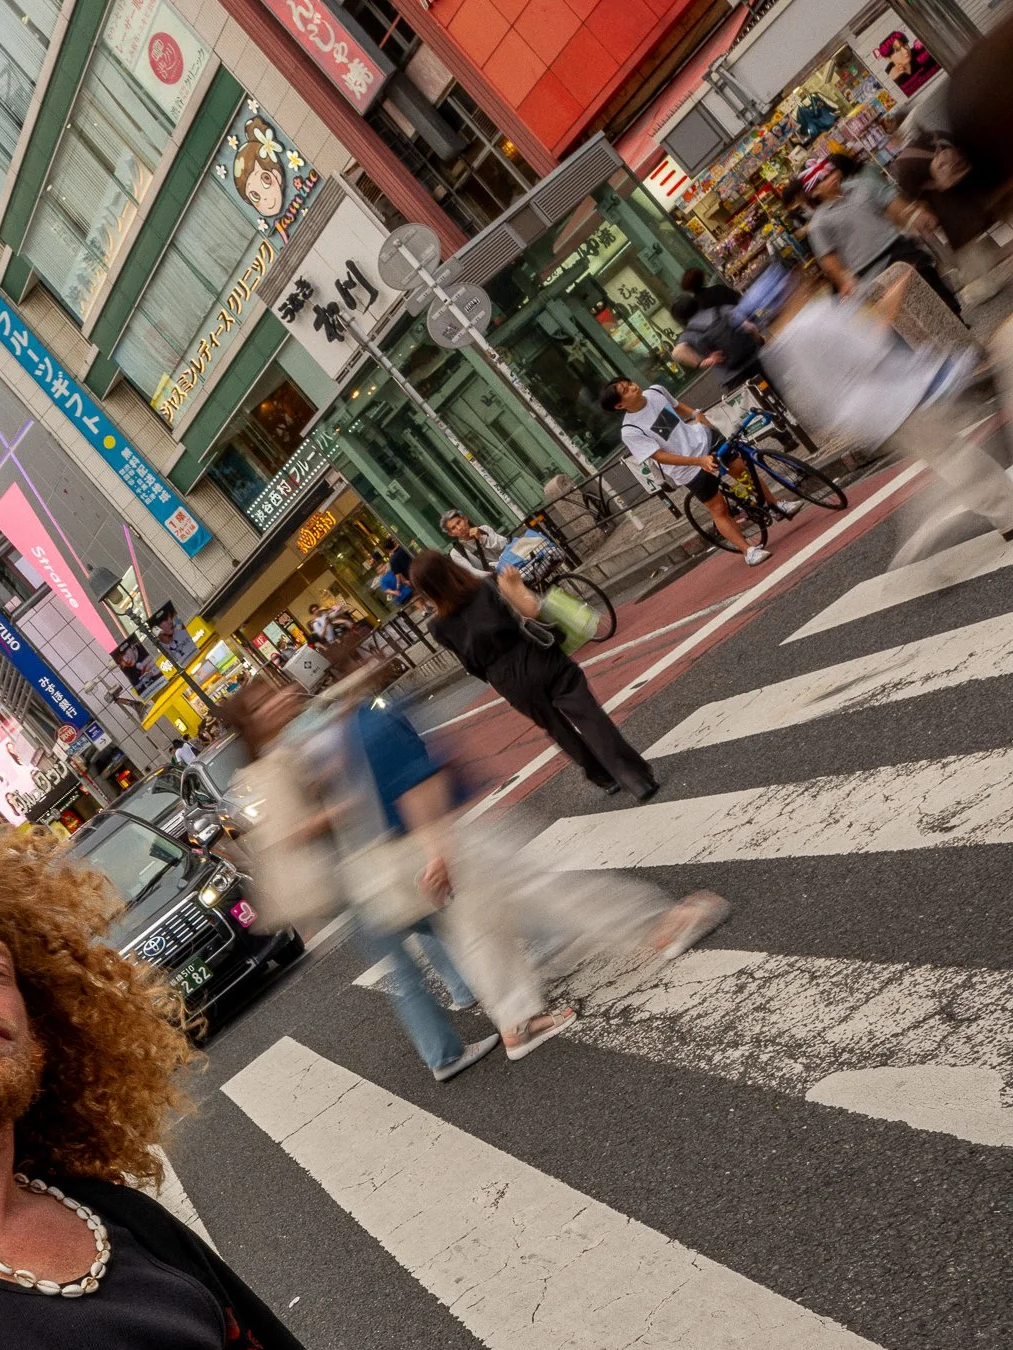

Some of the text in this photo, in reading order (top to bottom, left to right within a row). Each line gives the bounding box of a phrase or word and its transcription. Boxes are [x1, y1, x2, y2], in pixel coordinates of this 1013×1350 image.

[159, 239, 275, 424] ジャスミンレディースクリニック
[30, 545, 80, 609] Straine
[37, 676, 78, 719] みずほ銀行
[181, 964, 194, 977] 510
